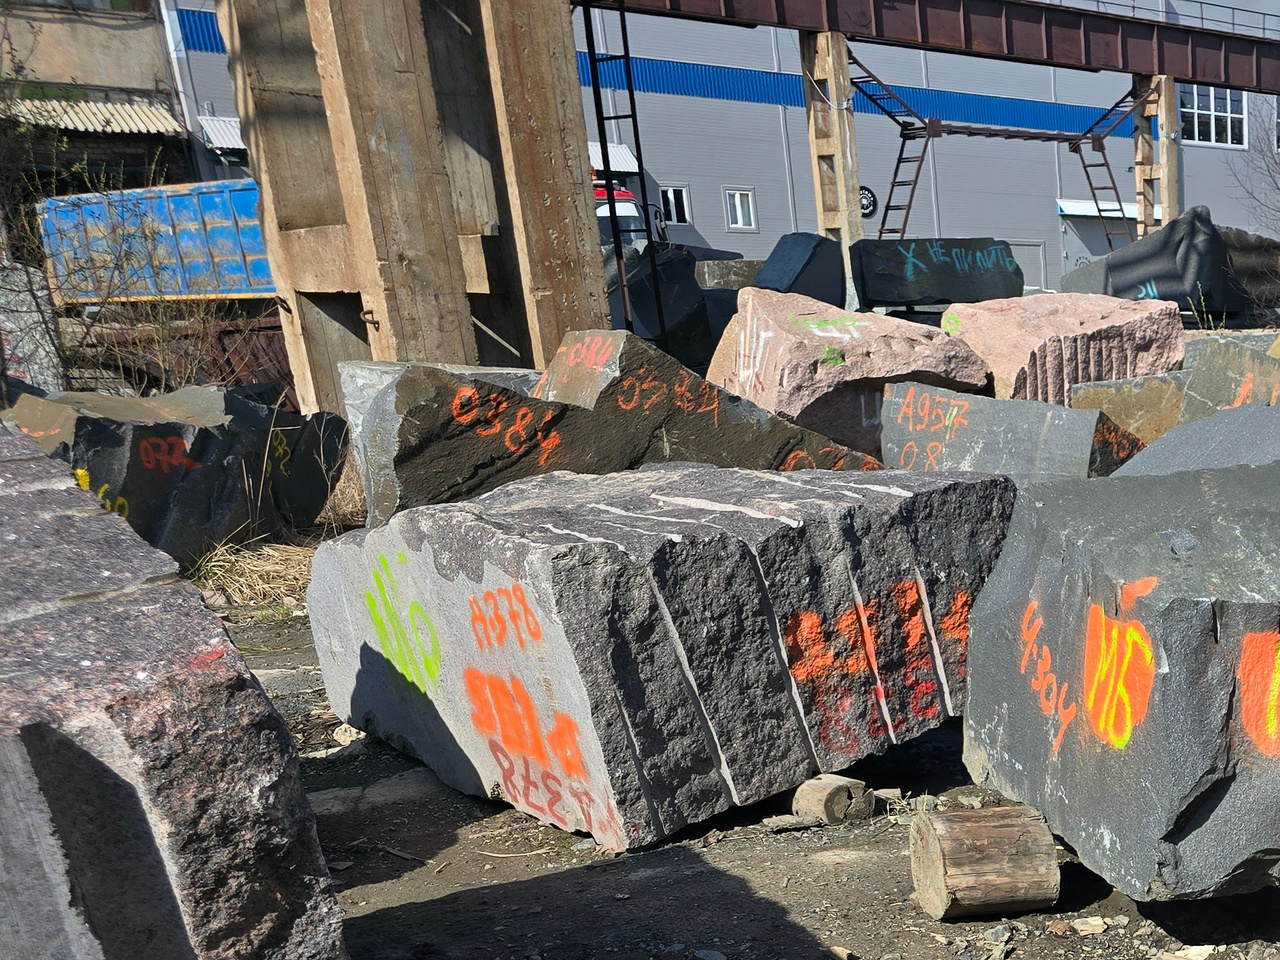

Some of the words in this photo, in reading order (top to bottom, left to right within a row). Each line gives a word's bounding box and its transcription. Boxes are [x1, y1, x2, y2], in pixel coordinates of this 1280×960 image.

[926, 241, 950, 263] НЕ
[452, 386, 561, 467] 0384
[469, 582, 541, 652] А378
